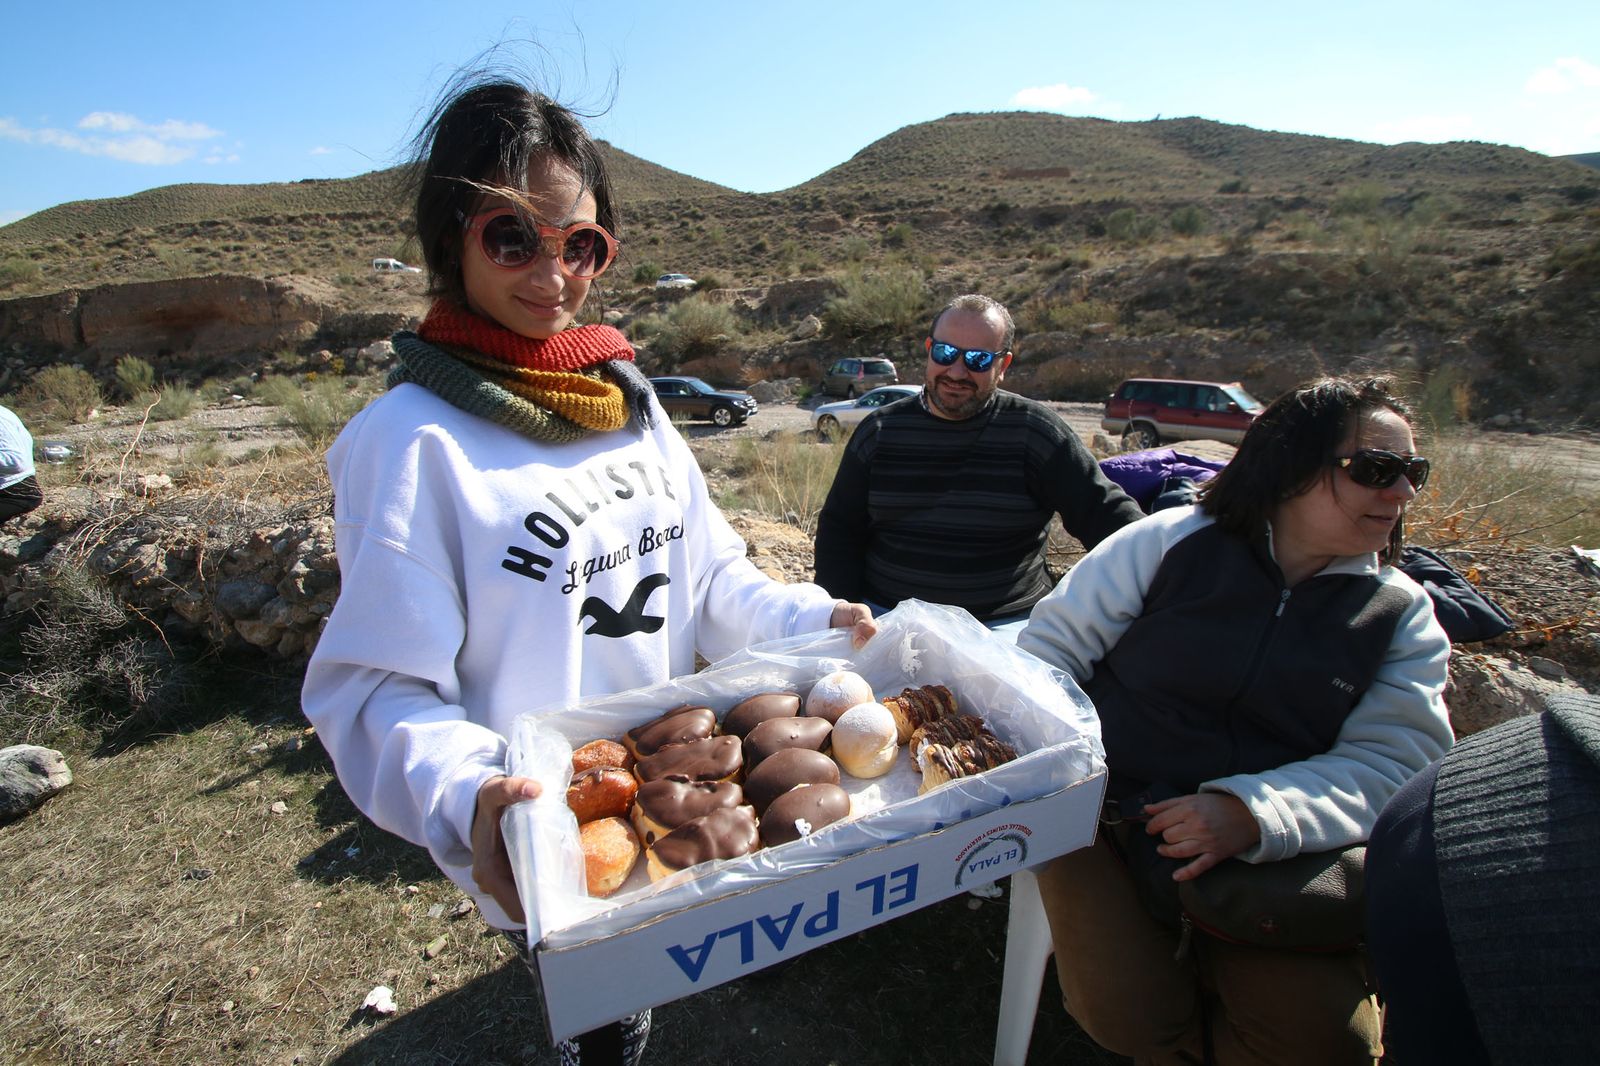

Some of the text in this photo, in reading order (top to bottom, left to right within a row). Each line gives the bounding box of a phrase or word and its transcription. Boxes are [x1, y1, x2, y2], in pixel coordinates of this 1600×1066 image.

[561, 544, 631, 594] Lguna
[955, 836, 982, 862] DERIVADOS
[969, 848, 1018, 873] EL PALA
[665, 863, 919, 983] EL PALA
